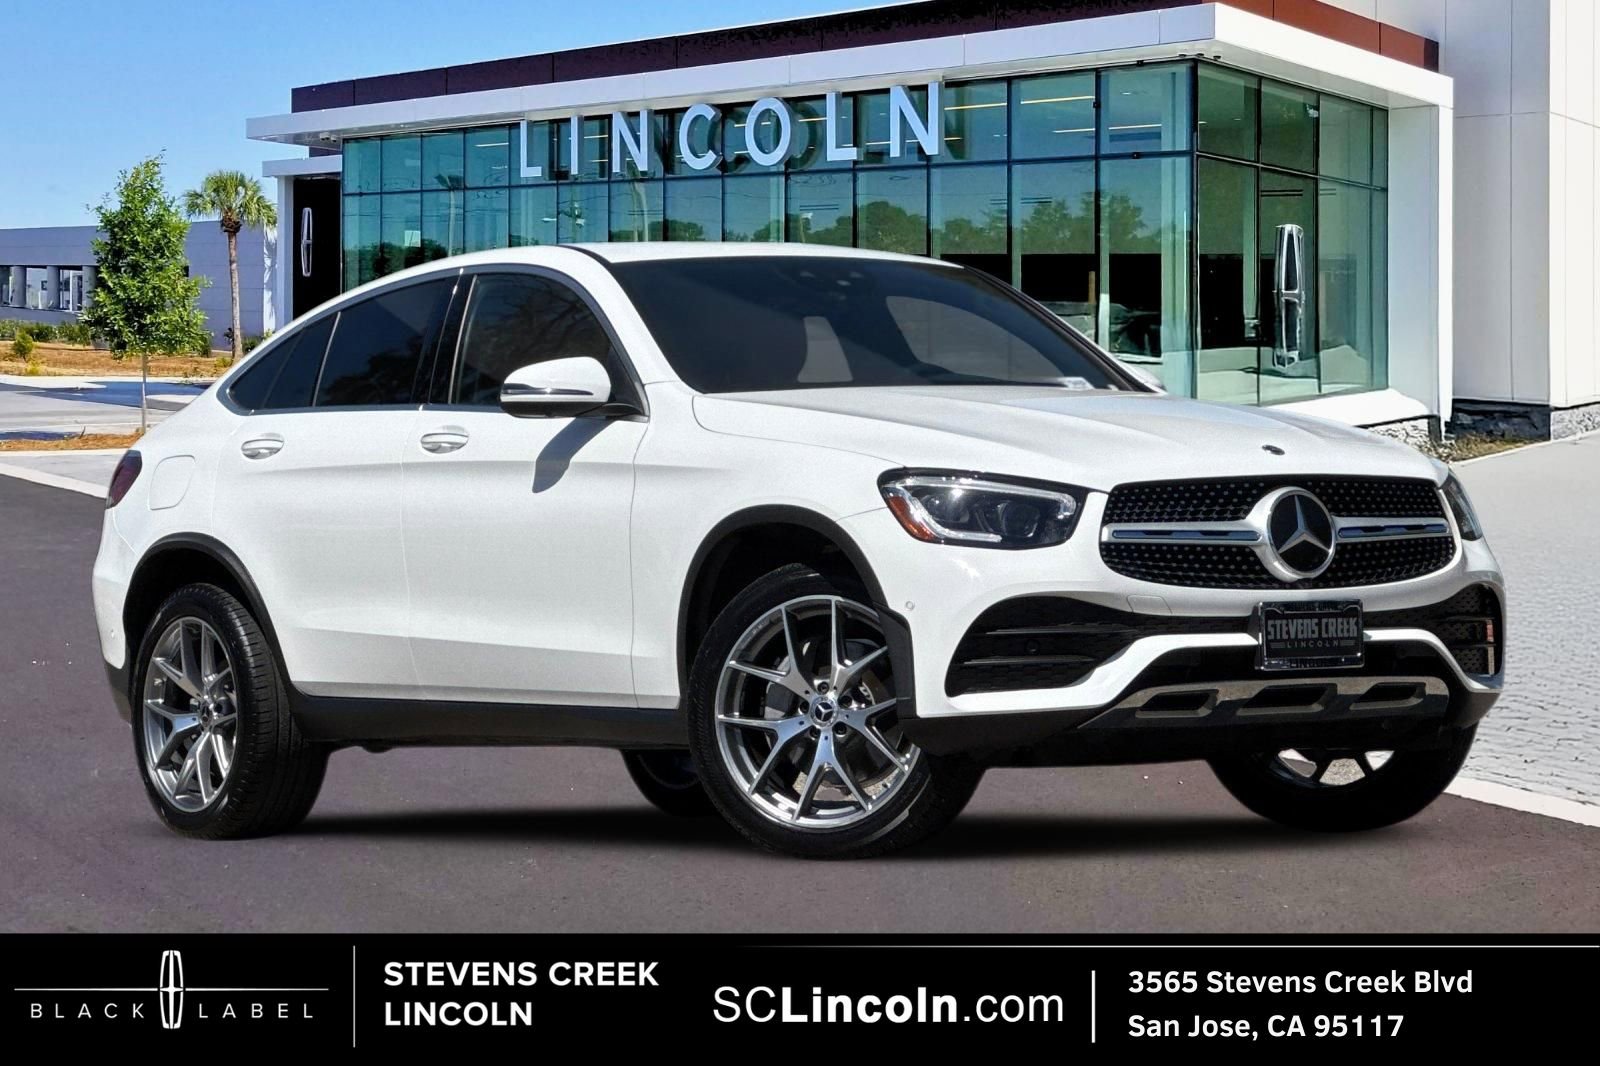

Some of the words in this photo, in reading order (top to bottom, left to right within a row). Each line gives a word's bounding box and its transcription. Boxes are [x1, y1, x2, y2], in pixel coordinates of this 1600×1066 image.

[519, 81, 942, 178] LINCOLN
[1267, 618, 1319, 640] STEVENS
[1321, 617, 1358, 638] CREEK
[1287, 640, 1339, 649] LINCOLN
